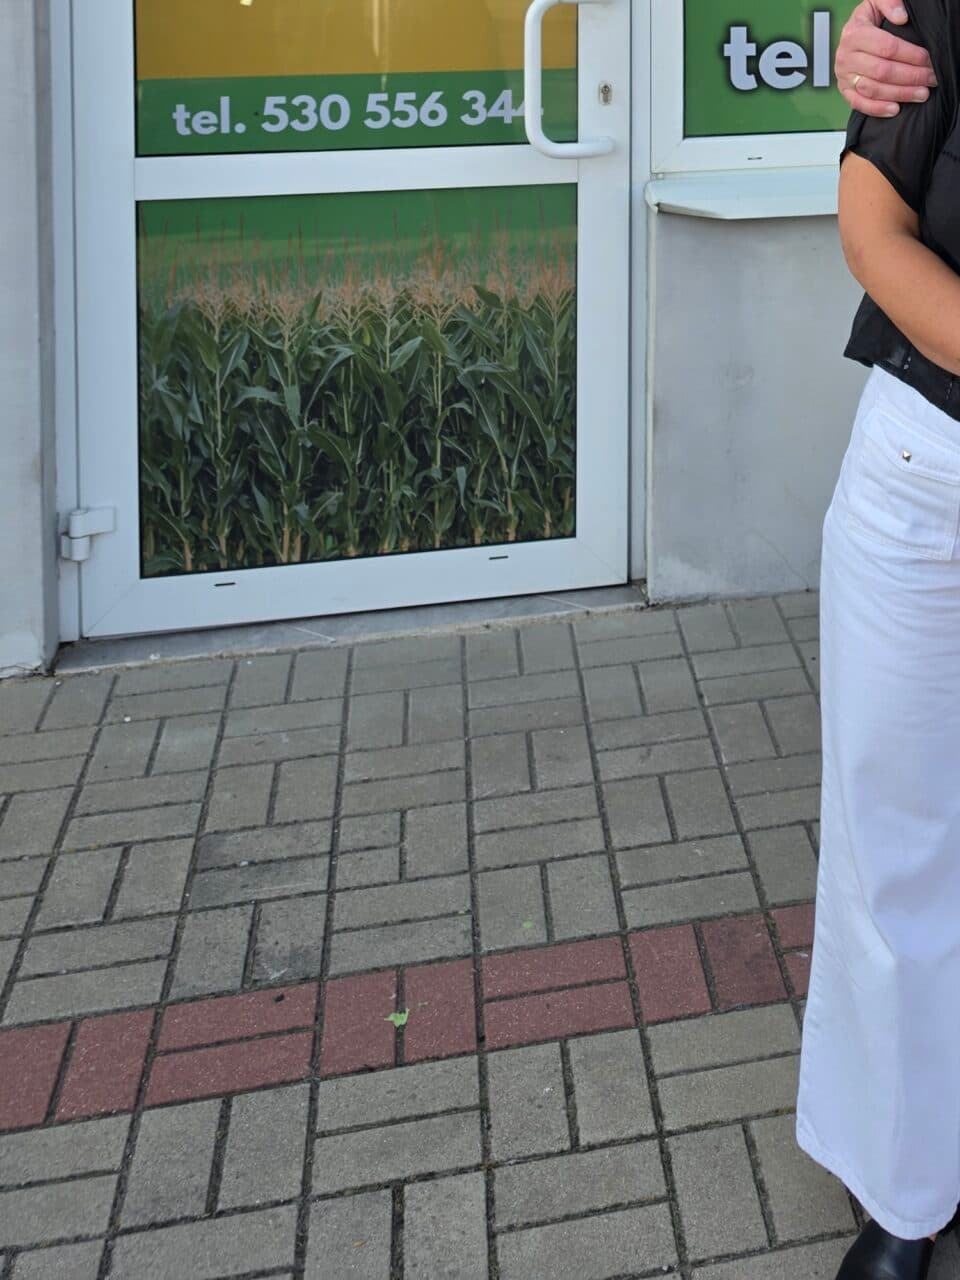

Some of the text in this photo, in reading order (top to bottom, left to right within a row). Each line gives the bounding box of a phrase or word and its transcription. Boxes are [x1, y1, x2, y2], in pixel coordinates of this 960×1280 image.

[172, 95, 246, 136] tel.
[261, 93, 350, 133] 530
[364, 90, 448, 130] 556
